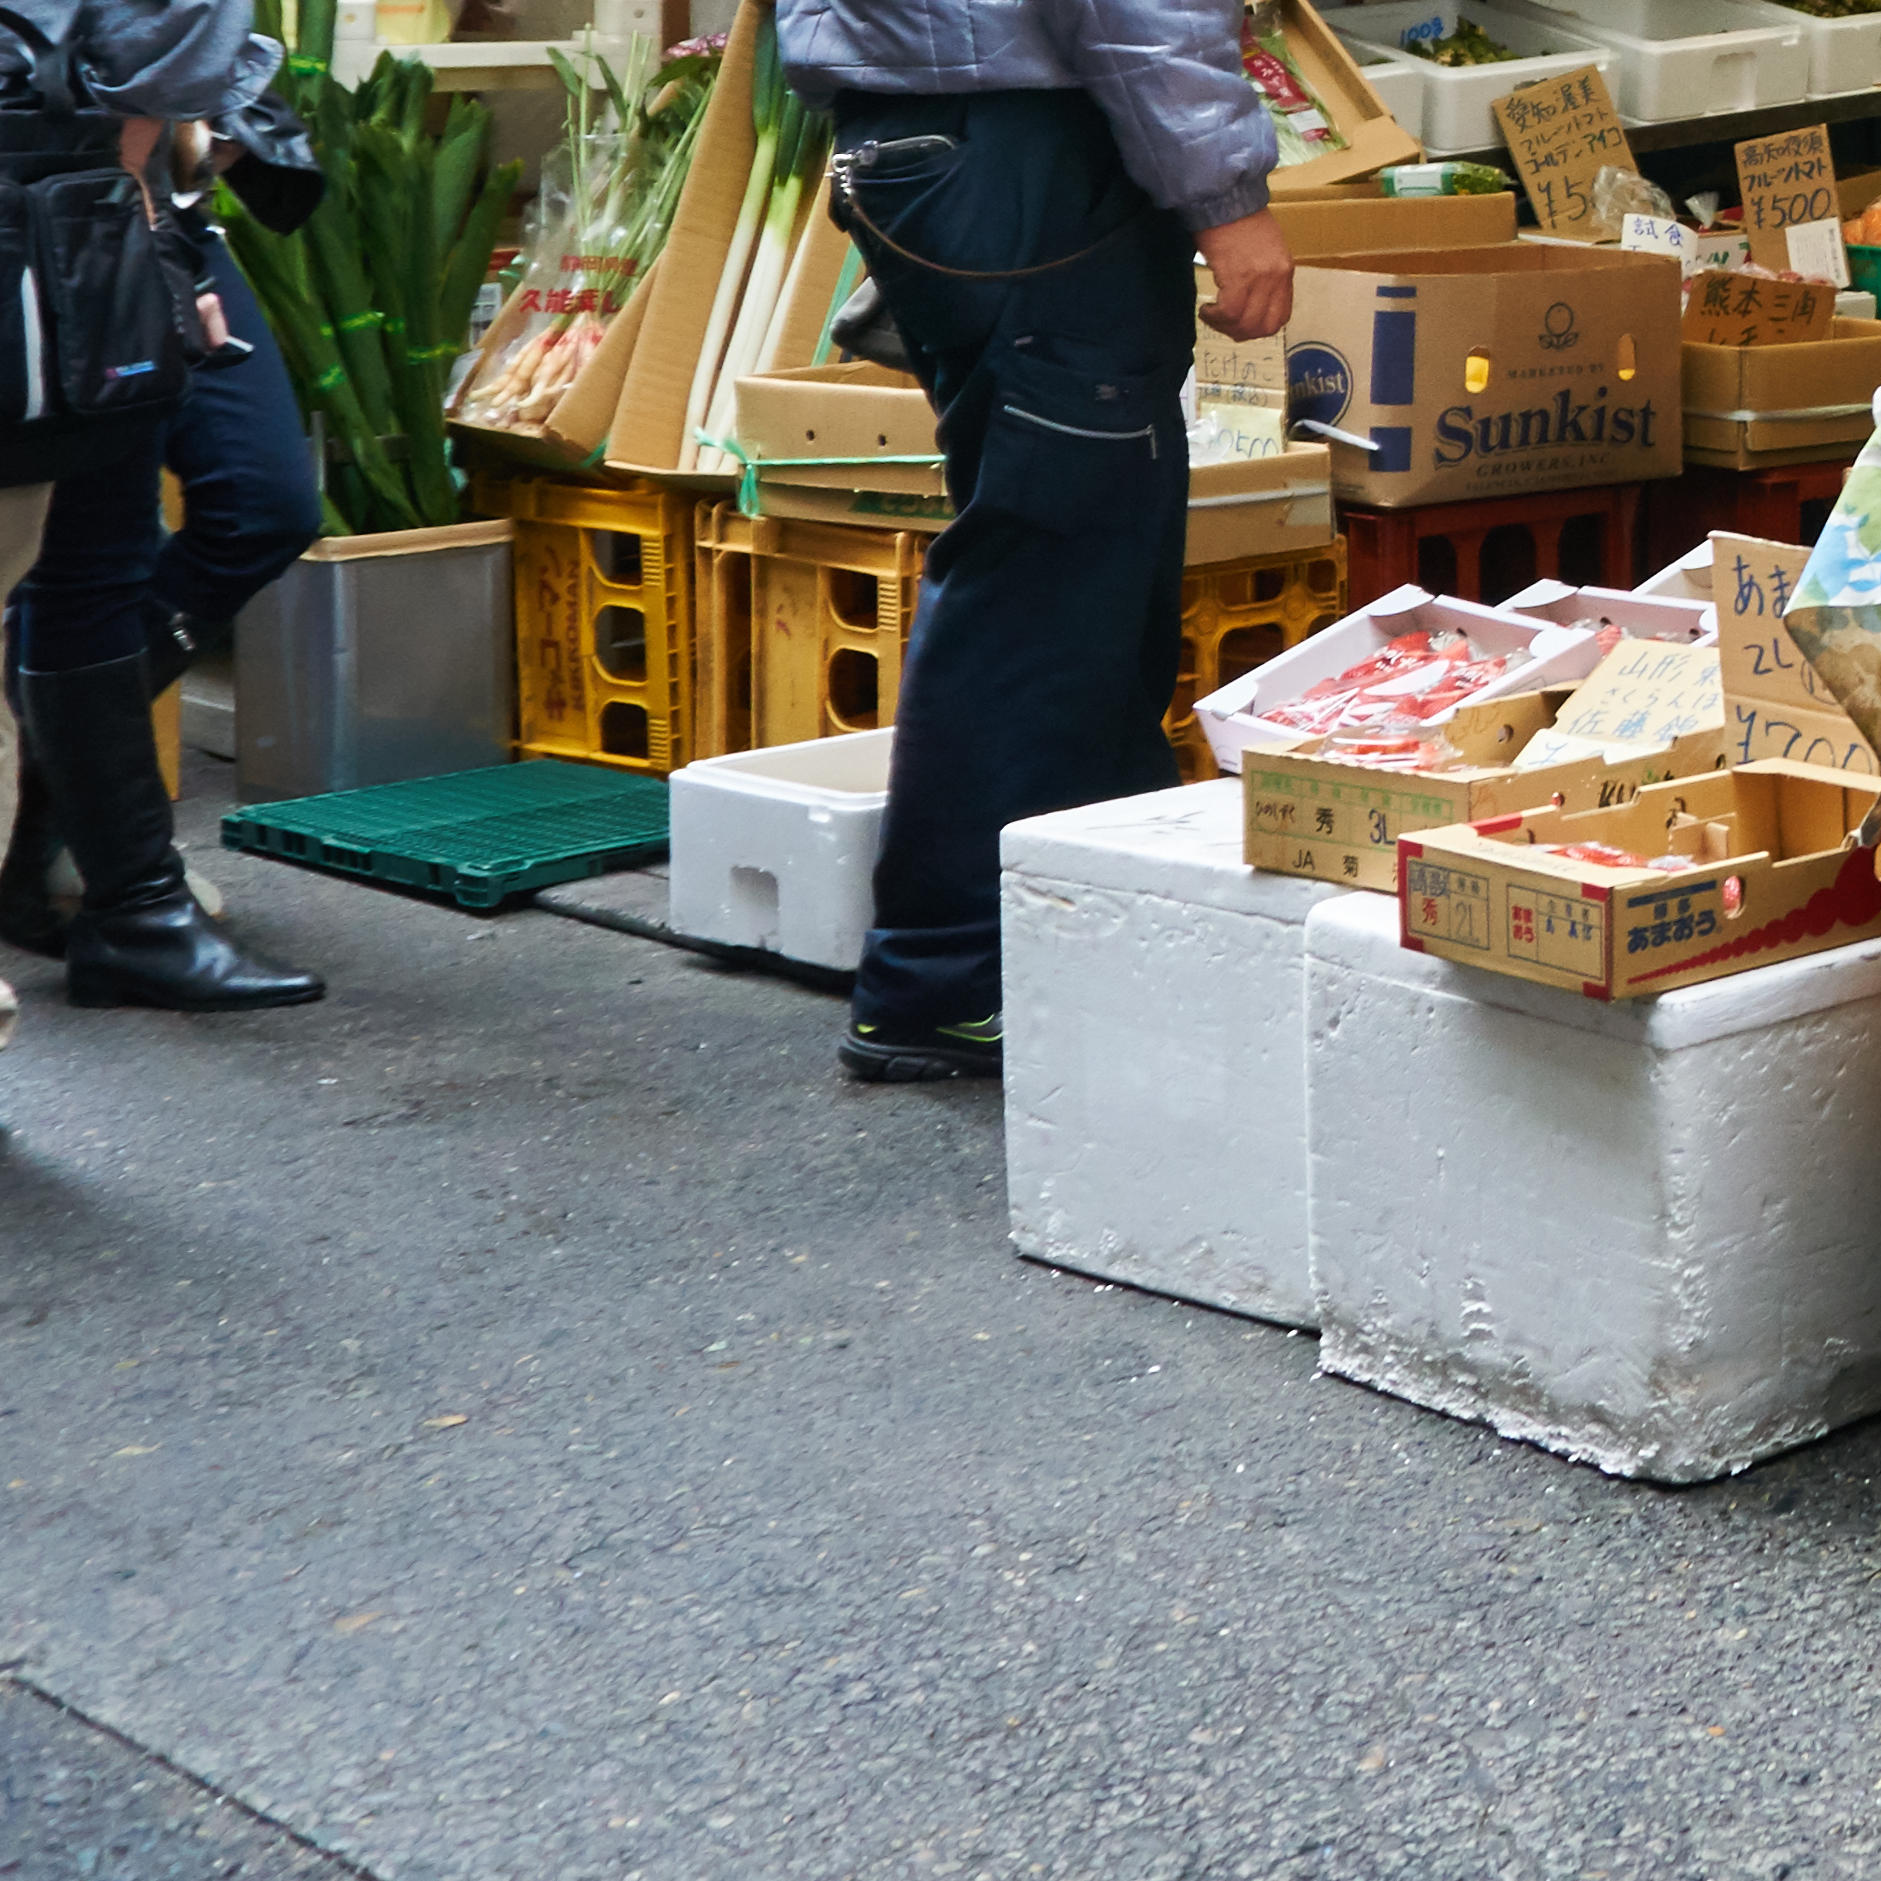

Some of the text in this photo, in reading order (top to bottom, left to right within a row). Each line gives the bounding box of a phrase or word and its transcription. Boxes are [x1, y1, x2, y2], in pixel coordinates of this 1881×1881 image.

[1433, 385, 1658, 472] Sunkist
[1292, 848, 1316, 872] JA
[1626, 908, 1718, 955] あまおう
